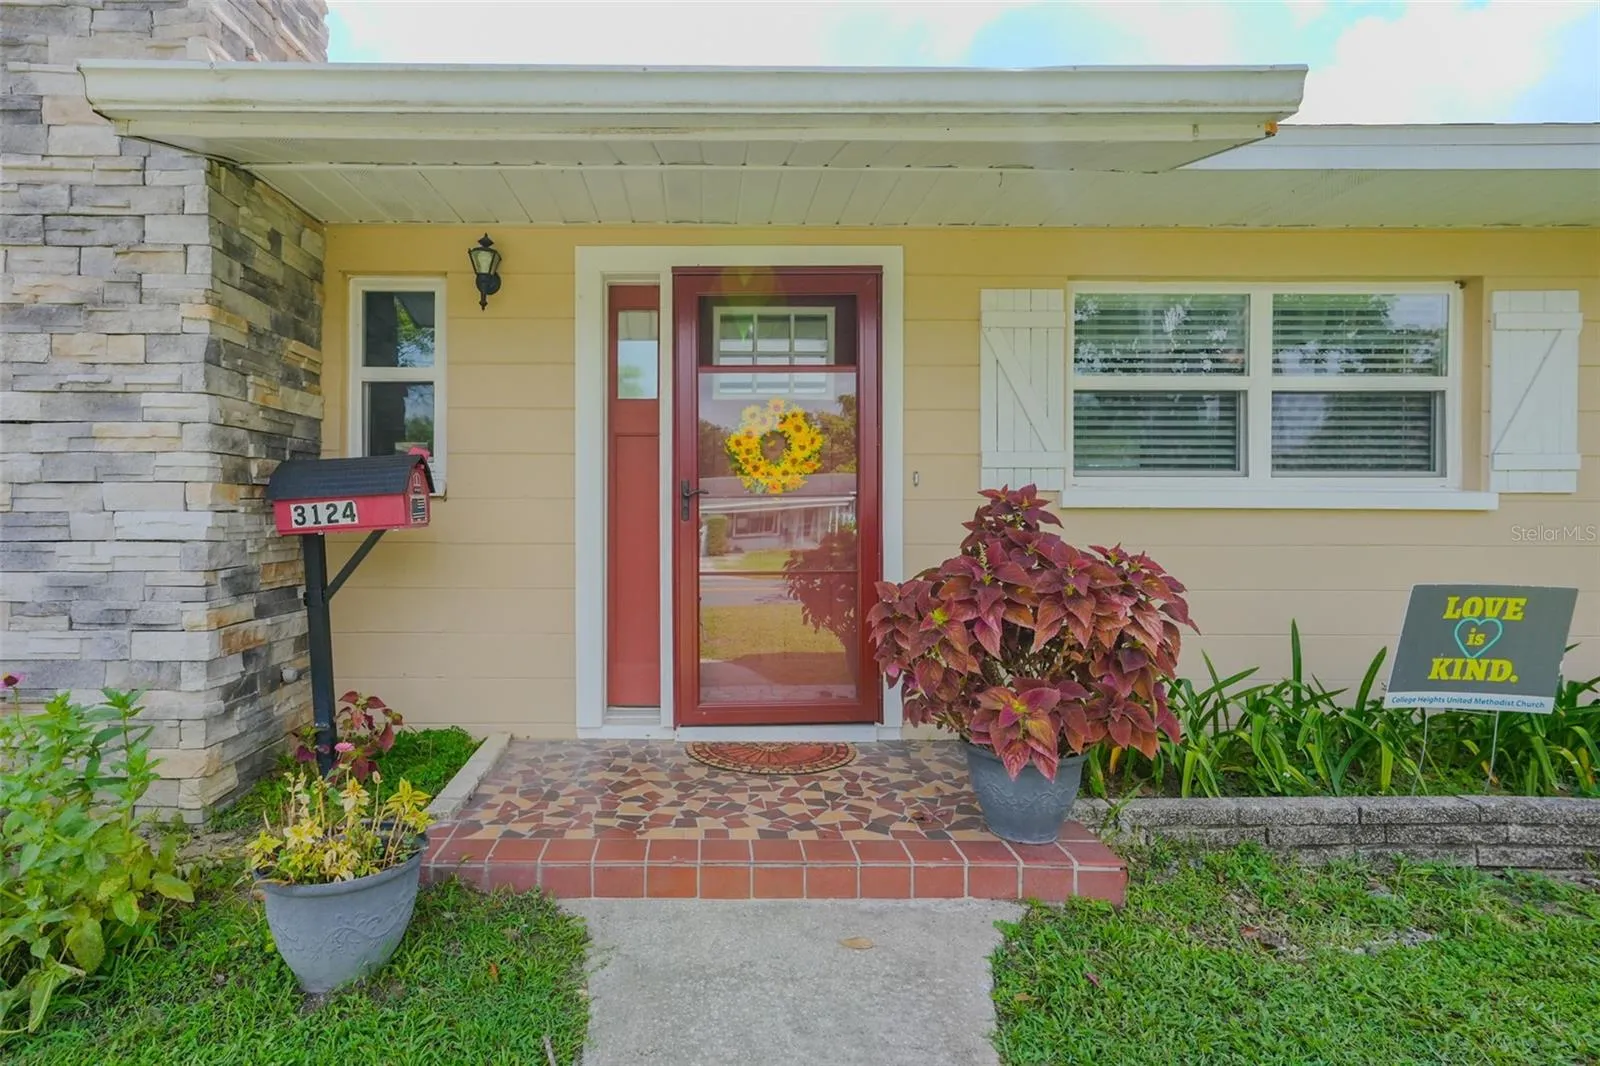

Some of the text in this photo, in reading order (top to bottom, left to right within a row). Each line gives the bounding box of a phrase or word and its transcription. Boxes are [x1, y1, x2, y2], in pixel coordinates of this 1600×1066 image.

[293, 501, 356, 526] 3124
[1443, 596, 1527, 620] LOVE
[1466, 628, 1486, 646] is
[1428, 657, 1519, 682] KIND.
[1391, 696, 1545, 708] College Heights United Methodist Church
